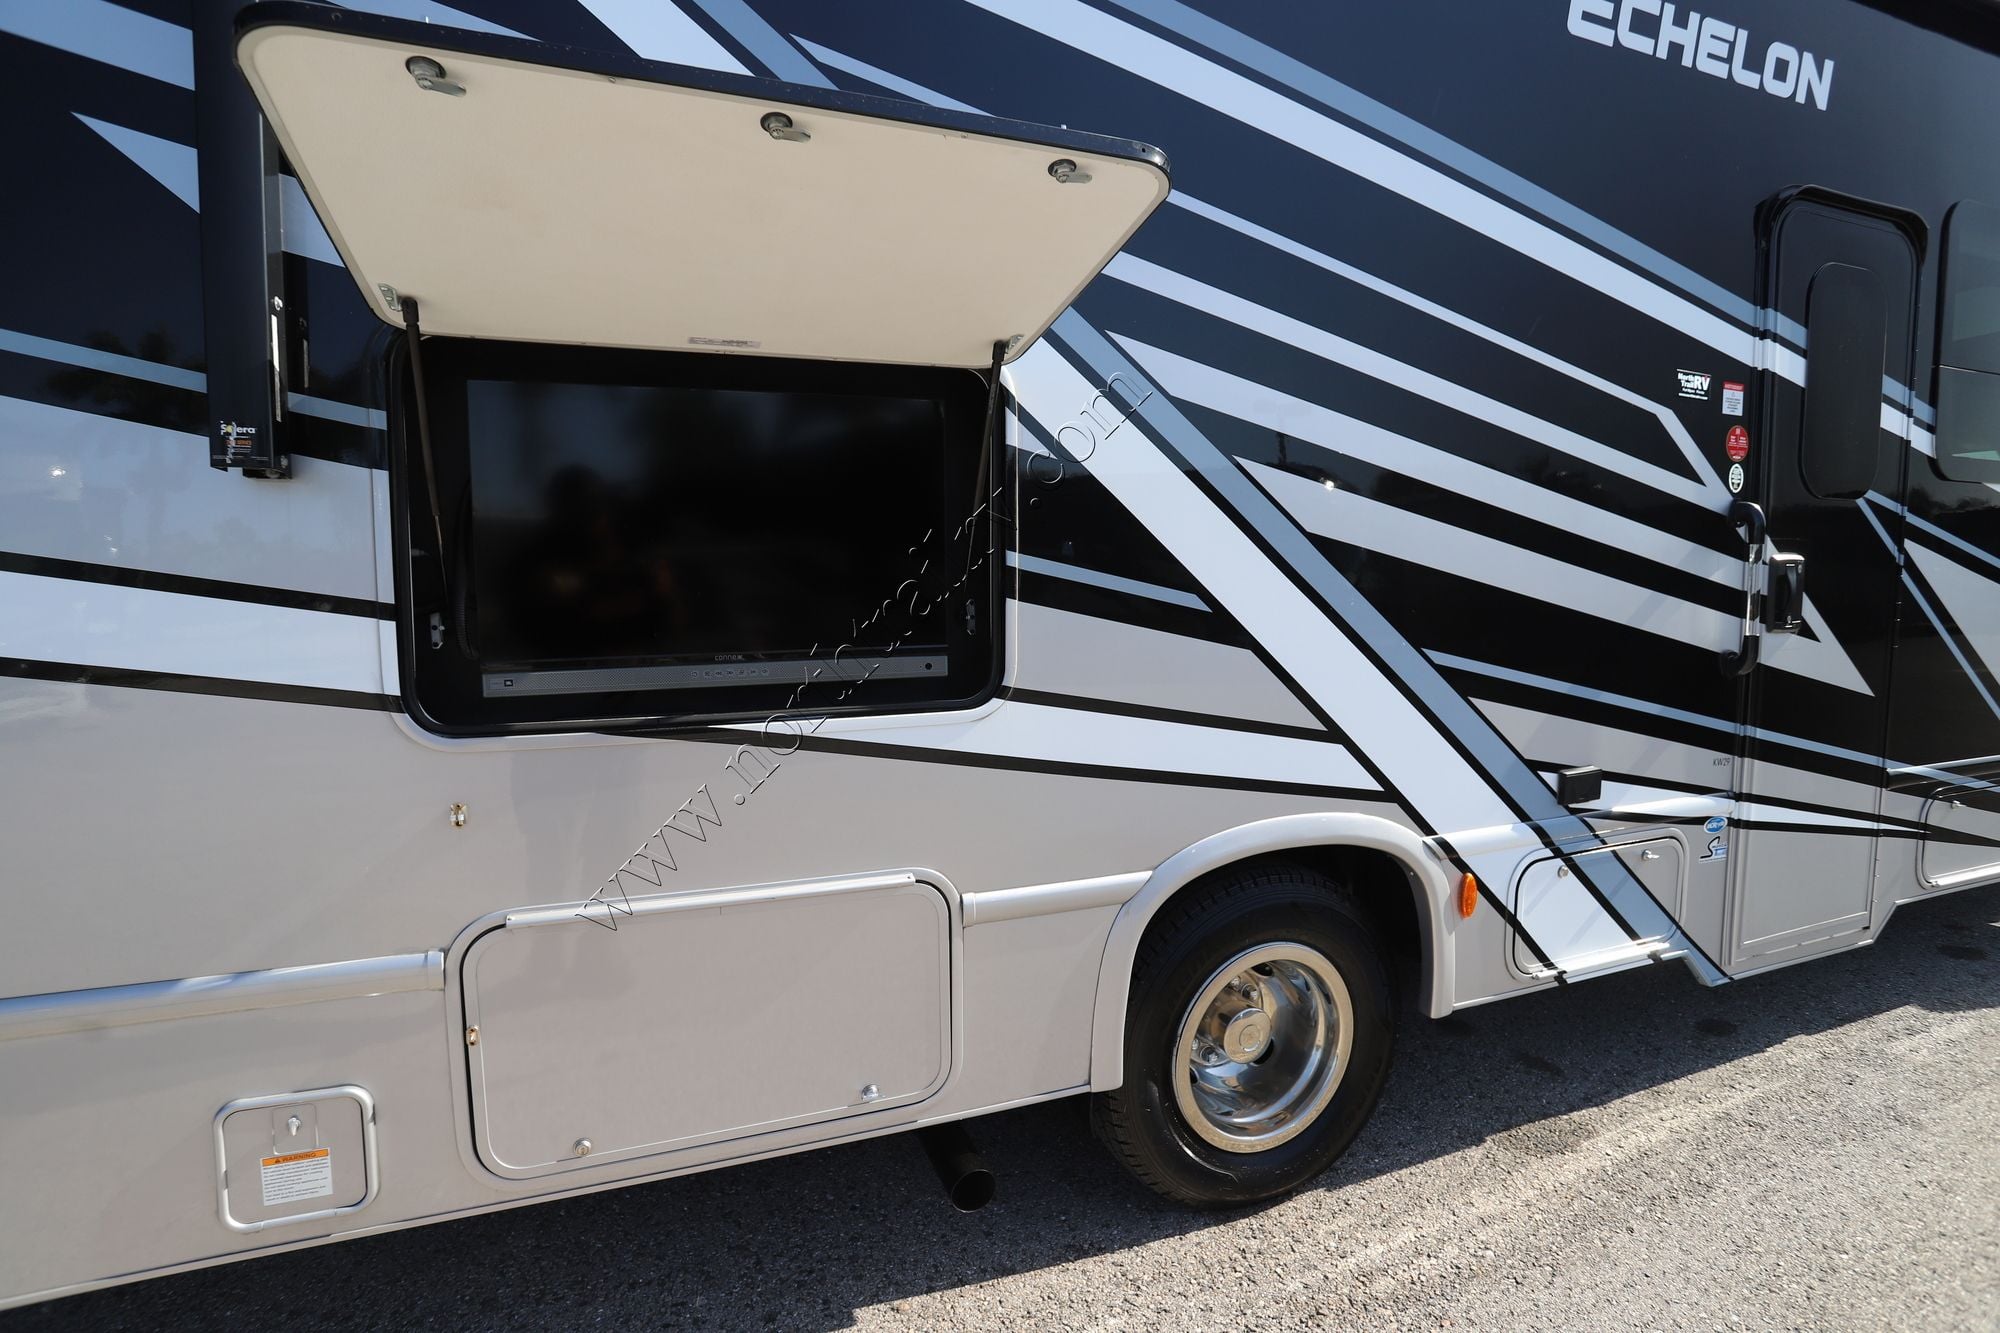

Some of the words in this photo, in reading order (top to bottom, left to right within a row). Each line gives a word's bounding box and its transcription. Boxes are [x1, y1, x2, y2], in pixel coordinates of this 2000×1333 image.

[1567, 0, 1835, 111] ECHELON
[1694, 375, 1711, 391] RV
[282, 1152, 316, 1163] WARNING
